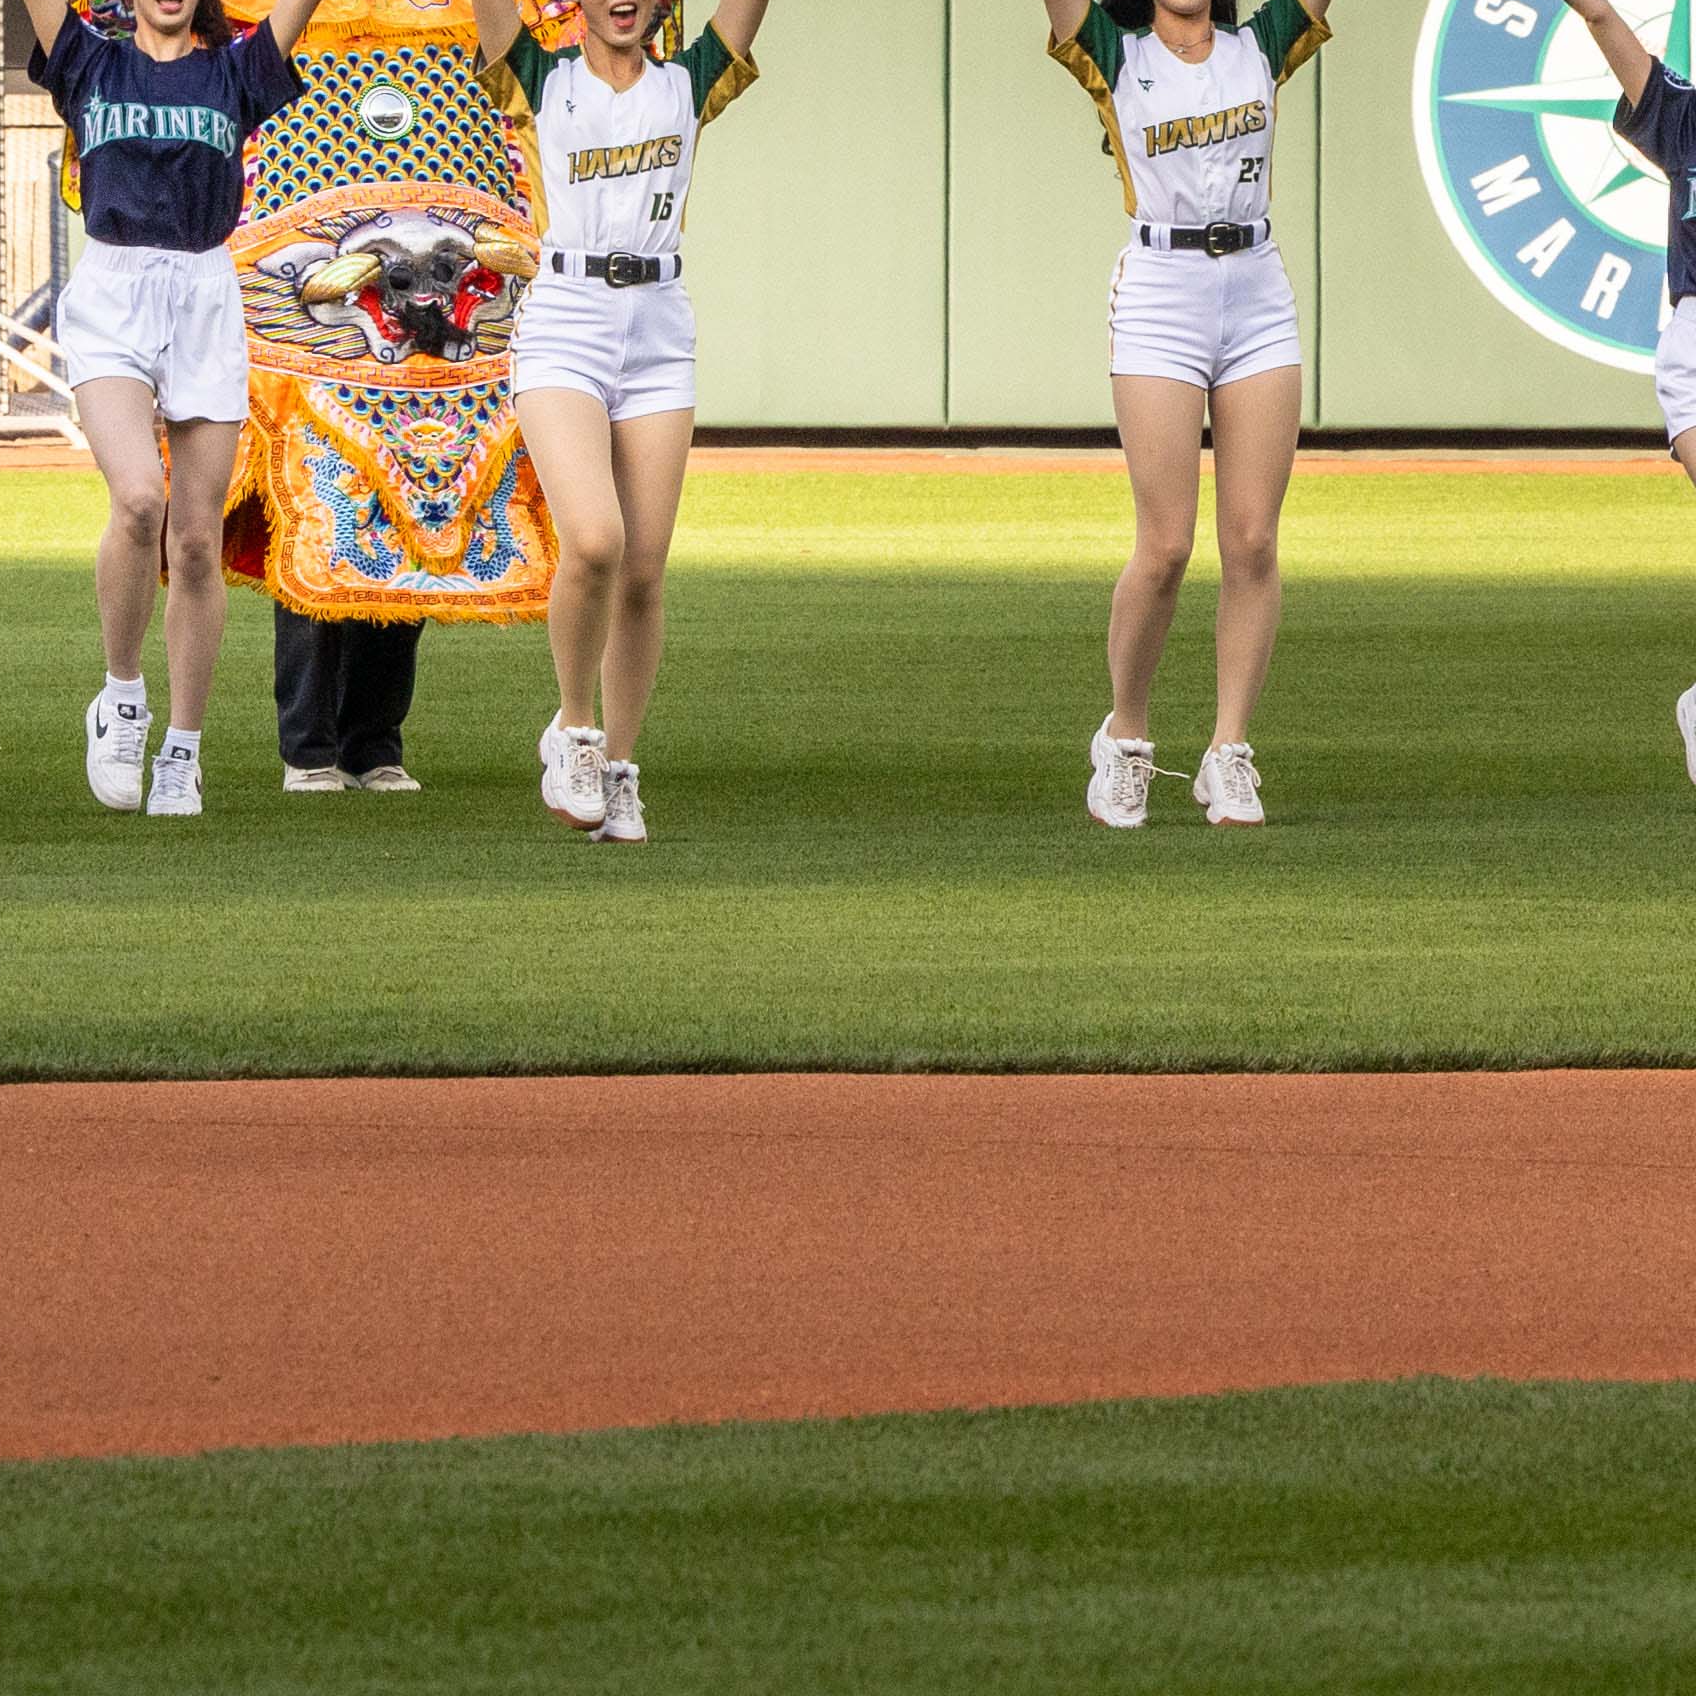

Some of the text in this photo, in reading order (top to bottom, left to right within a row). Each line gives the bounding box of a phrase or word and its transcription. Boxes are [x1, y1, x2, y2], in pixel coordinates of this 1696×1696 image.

[79, 101, 238, 159] MARINERS
[1142, 99, 1267, 158] HAWKS
[567, 134, 683, 185] HAWKS
[649, 191, 675, 223] 16
